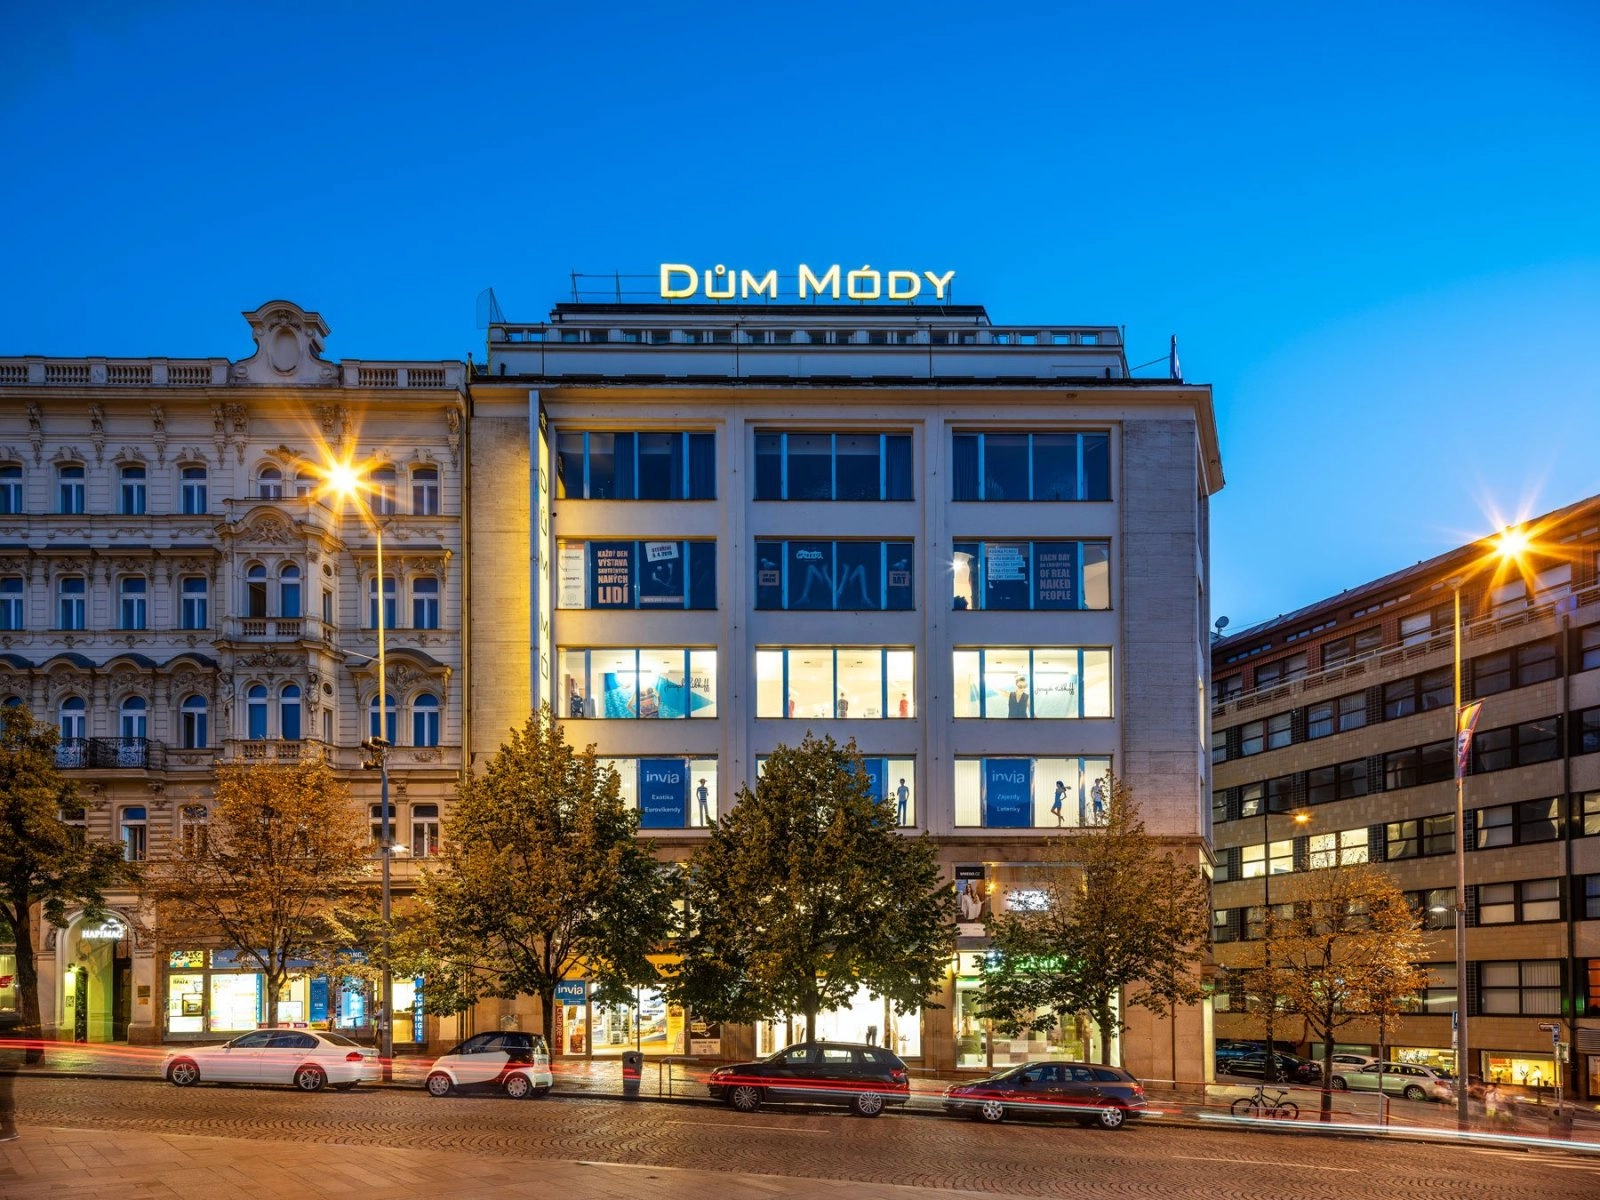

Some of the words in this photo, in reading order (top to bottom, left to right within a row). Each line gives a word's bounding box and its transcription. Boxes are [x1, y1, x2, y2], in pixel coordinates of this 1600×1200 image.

[799, 264, 956, 299] MÓDY
[1040, 569, 1051, 578] OF
[1051, 569, 1071, 578] REAL
[1040, 579, 1071, 590] NAKED
[598, 583, 629, 604] LIDÍ
[1040, 590, 1071, 600] PEOPLE
[646, 770, 680, 784] invia
[992, 770, 1026, 784] invia
[82, 929, 124, 939] HAPIMAG
[557, 984, 584, 996] invia
